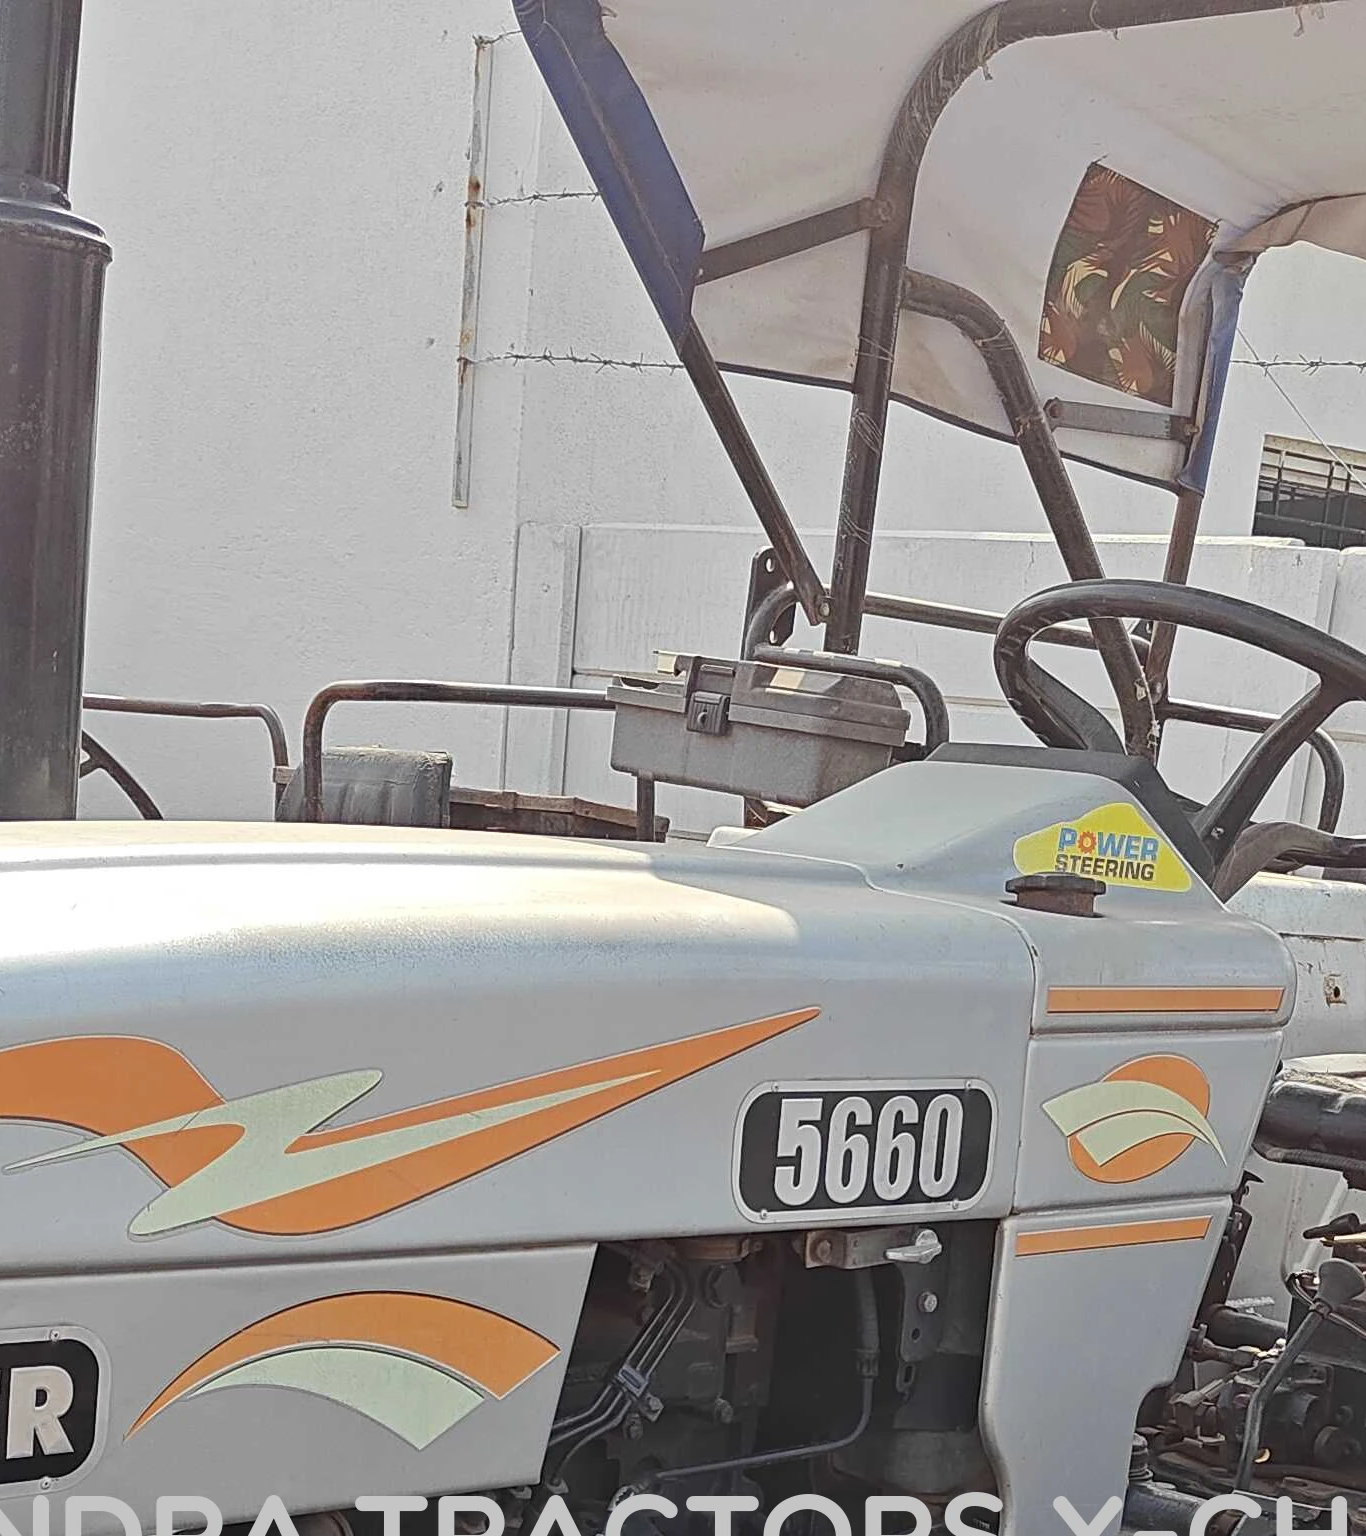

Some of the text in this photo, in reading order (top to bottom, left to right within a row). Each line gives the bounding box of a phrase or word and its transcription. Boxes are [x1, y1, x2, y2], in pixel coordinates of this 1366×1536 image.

[1058, 827, 1158, 861] POWER
[1055, 854, 1155, 880] STEERING
[774, 1094, 963, 1206] 5660
